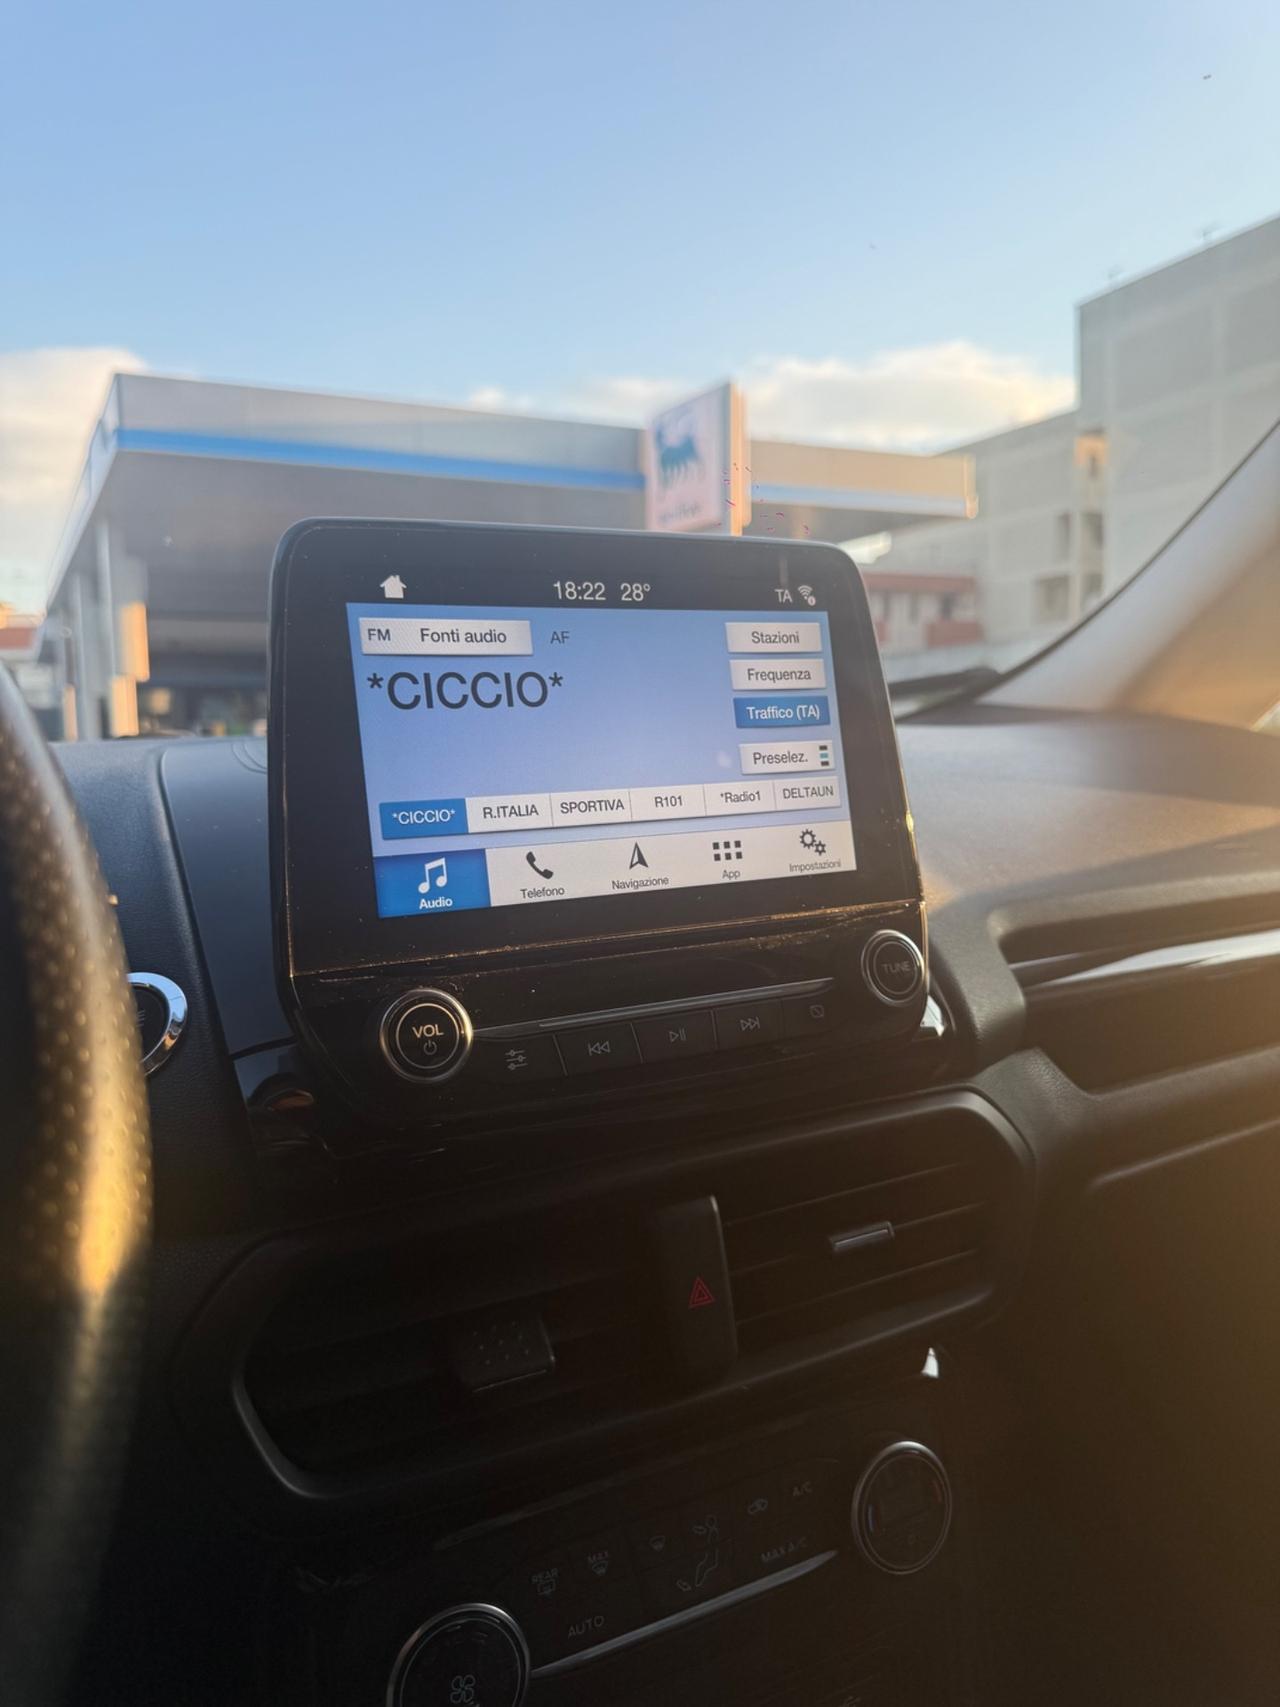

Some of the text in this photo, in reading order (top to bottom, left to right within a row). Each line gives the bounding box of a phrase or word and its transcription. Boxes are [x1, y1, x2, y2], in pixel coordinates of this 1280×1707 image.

[553, 581, 606, 601] 18:22
[620, 583, 651, 602] 28°
[775, 588, 793, 603] TA
[367, 628, 391, 642] FM
[420, 628, 507, 644] Fonti audio
[550, 631, 570, 645] AF
[751, 631, 800, 645] Stazioni
[747, 668, 811, 683] Frequenza
[746, 704, 820, 720] Traffico (TA)
[753, 750, 808, 766] Preselez.
[782, 785, 834, 800] DELTAUN
[560, 798, 625, 815] SPORTIVA
[654, 795, 683, 808] R101
[483, 804, 539, 820] R.ITALIA
[789, 858, 842, 873] Impostazioni
[722, 868, 741, 881] App
[611, 875, 670, 891] Navigazione
[520, 886, 565, 899] Telefono
[419, 896, 453, 910] Audio
[881, 961, 911, 977] TUNE
[412, 1024, 444, 1039] VOL
[567, 1615, 605, 1639] AUTO
